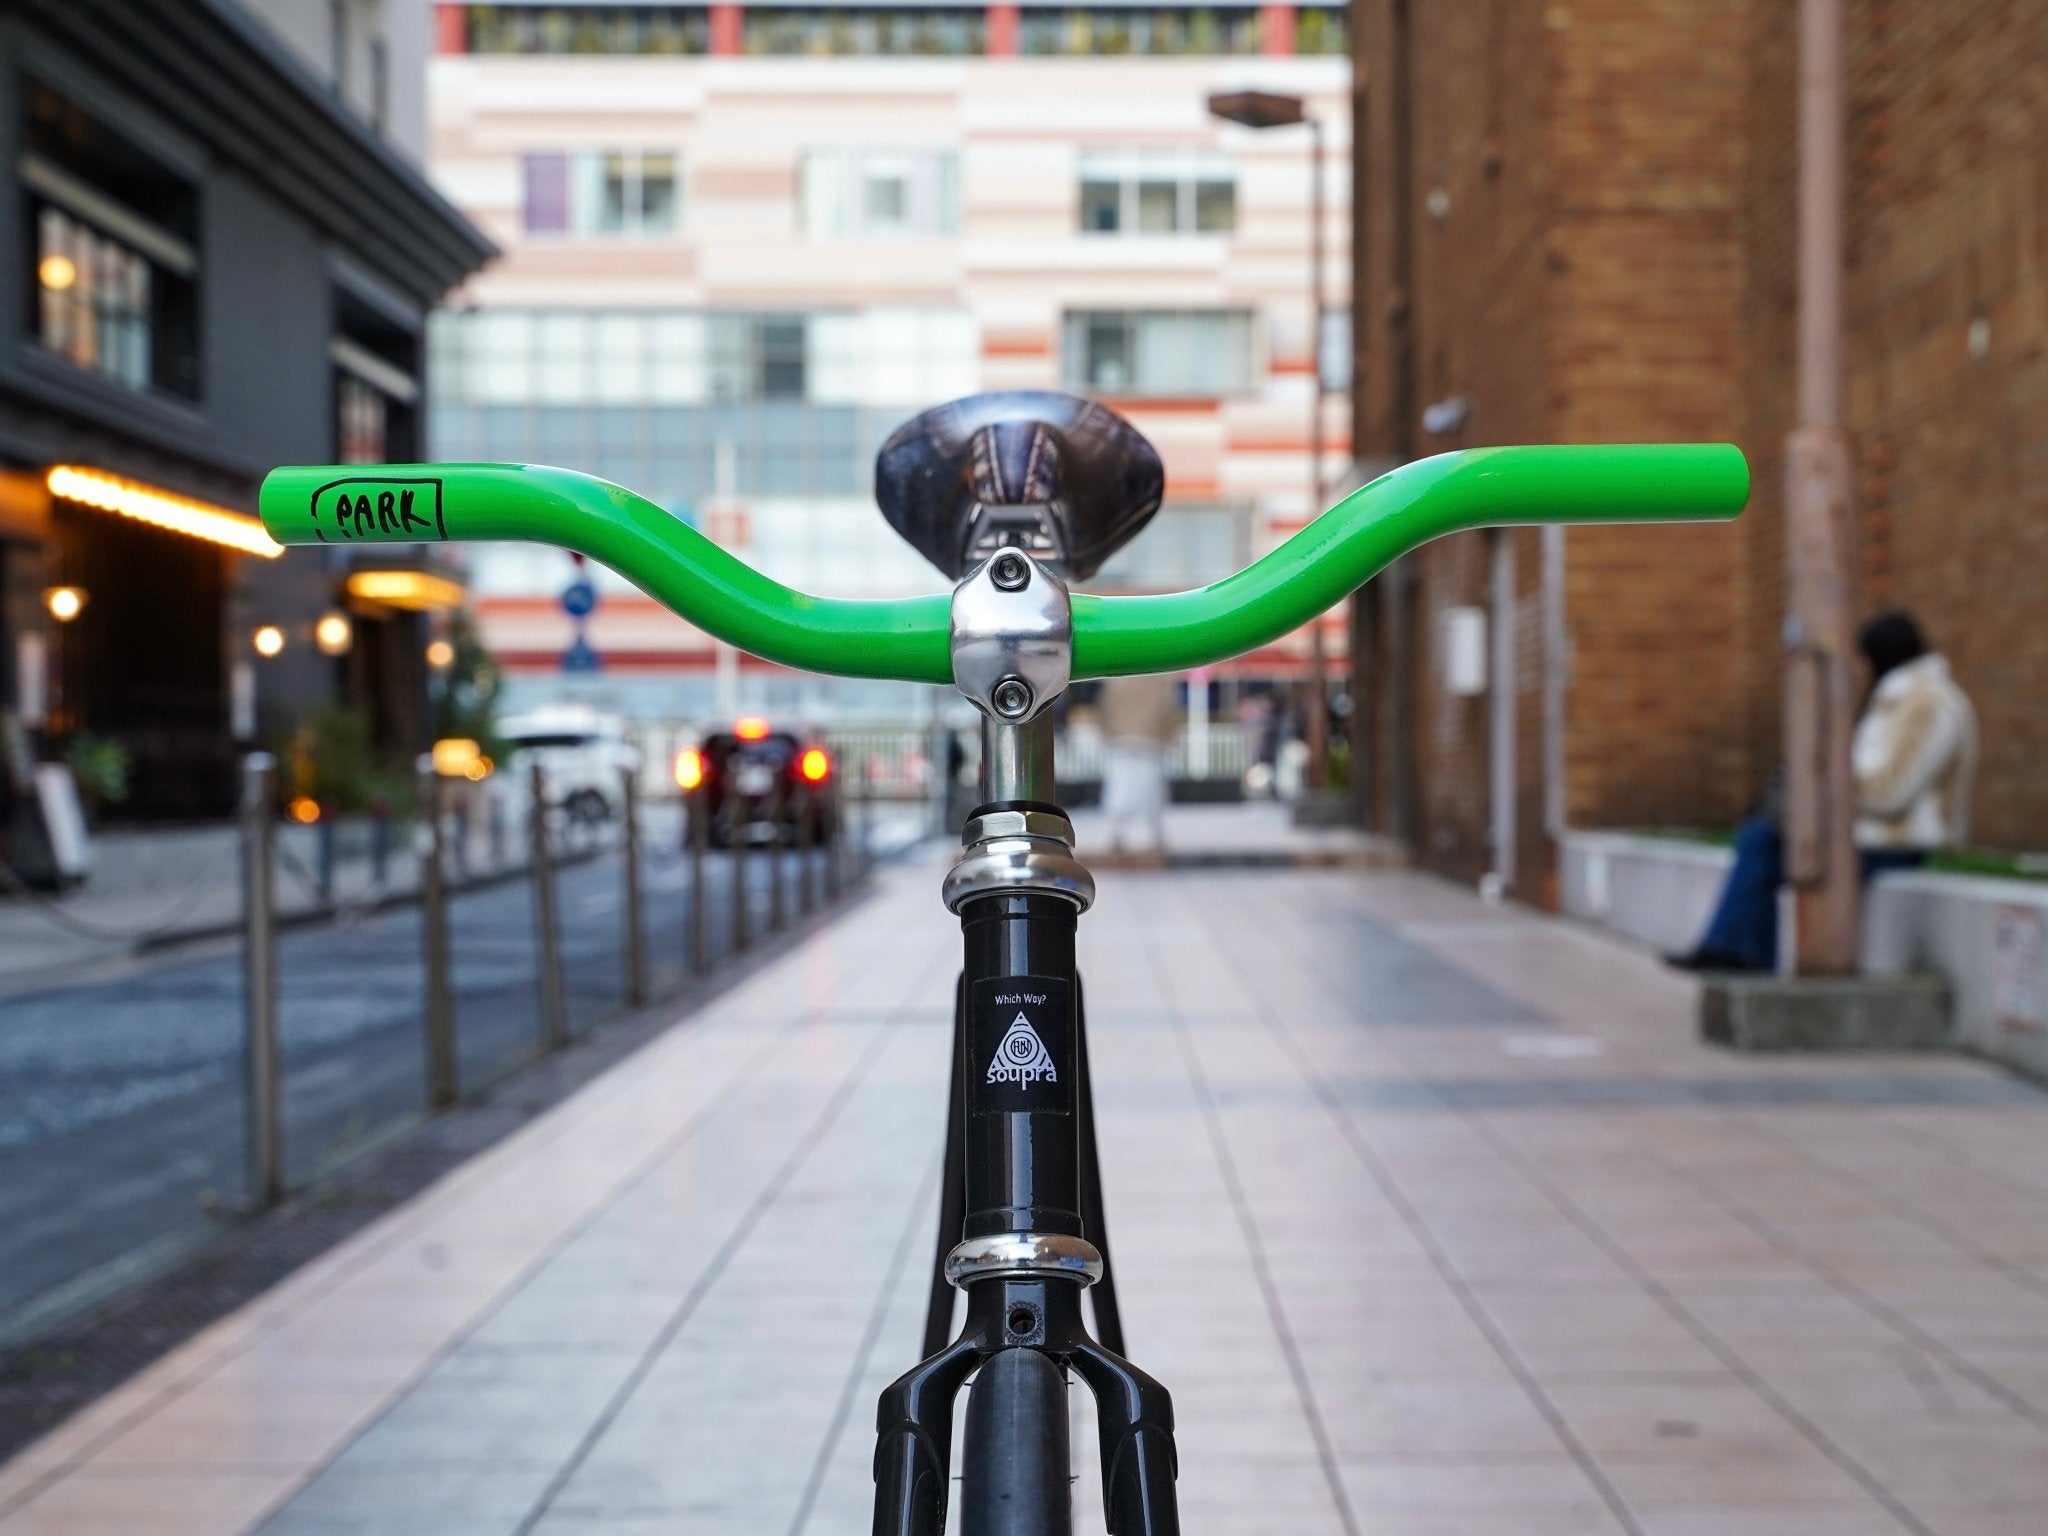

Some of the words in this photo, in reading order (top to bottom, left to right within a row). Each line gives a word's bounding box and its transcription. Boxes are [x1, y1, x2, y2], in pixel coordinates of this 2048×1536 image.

[336, 489, 431, 539] PARK
[995, 993, 1021, 1005] Which
[1024, 993, 1046, 1005] Way?
[987, 1068, 1057, 1090] soupra
